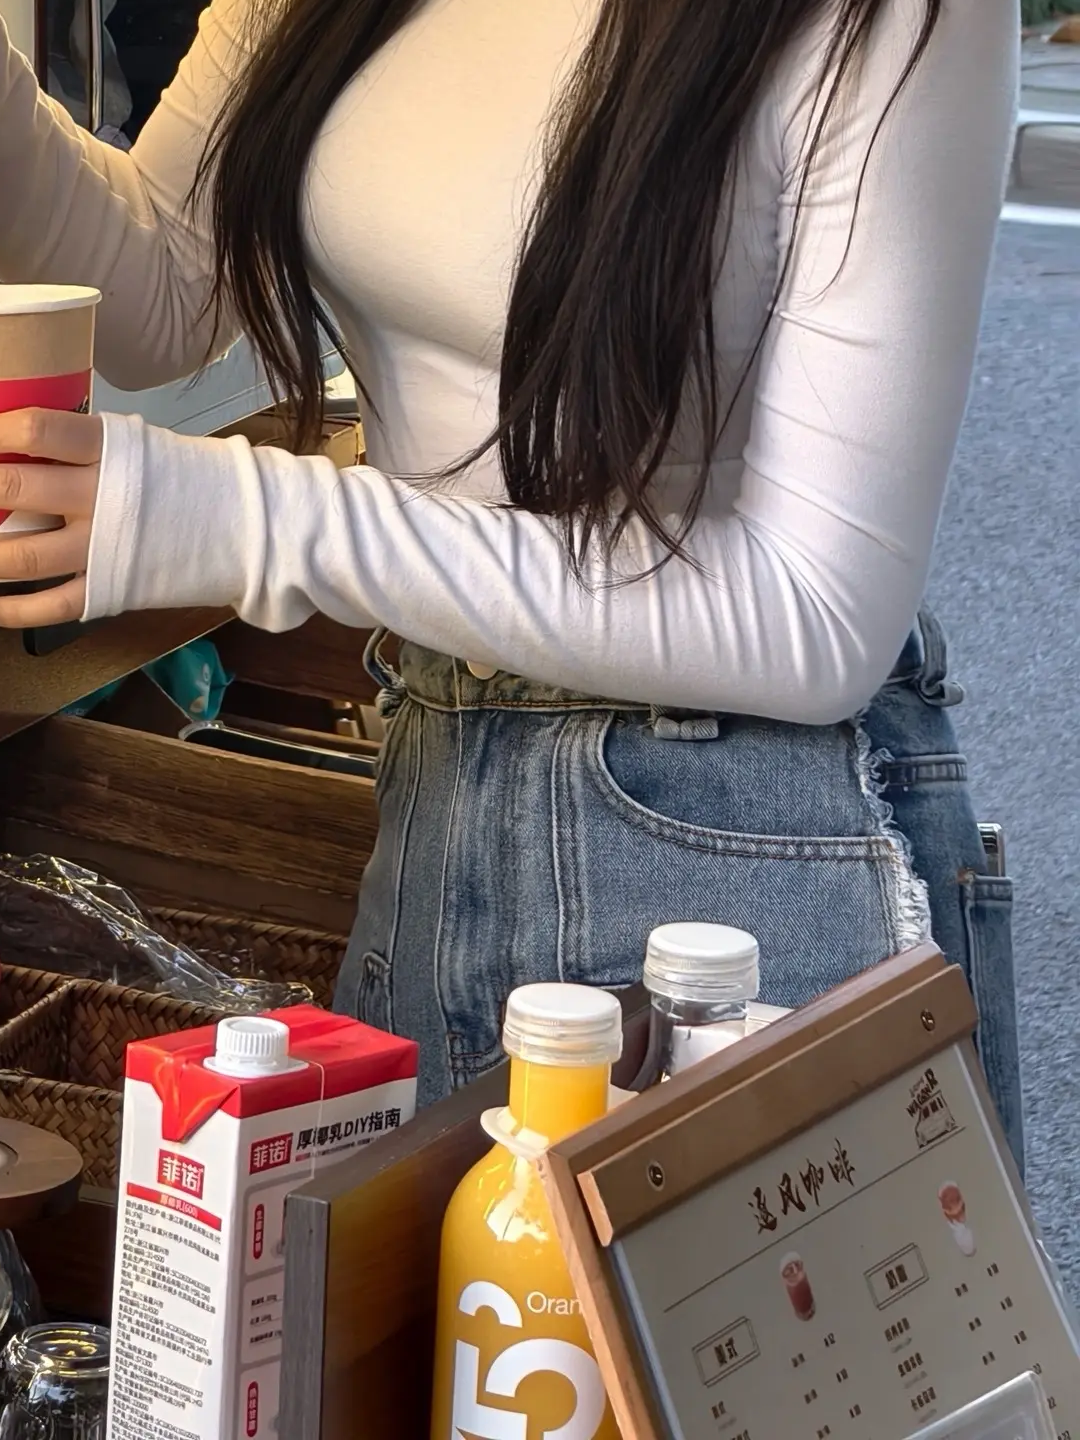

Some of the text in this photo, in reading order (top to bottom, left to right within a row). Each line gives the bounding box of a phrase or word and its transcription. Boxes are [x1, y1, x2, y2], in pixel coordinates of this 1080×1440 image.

[252, 1137, 292, 1168] 菲诺
[161, 1155, 204, 1194] 菲诺
[526, 1291, 582, 1315] Oran
